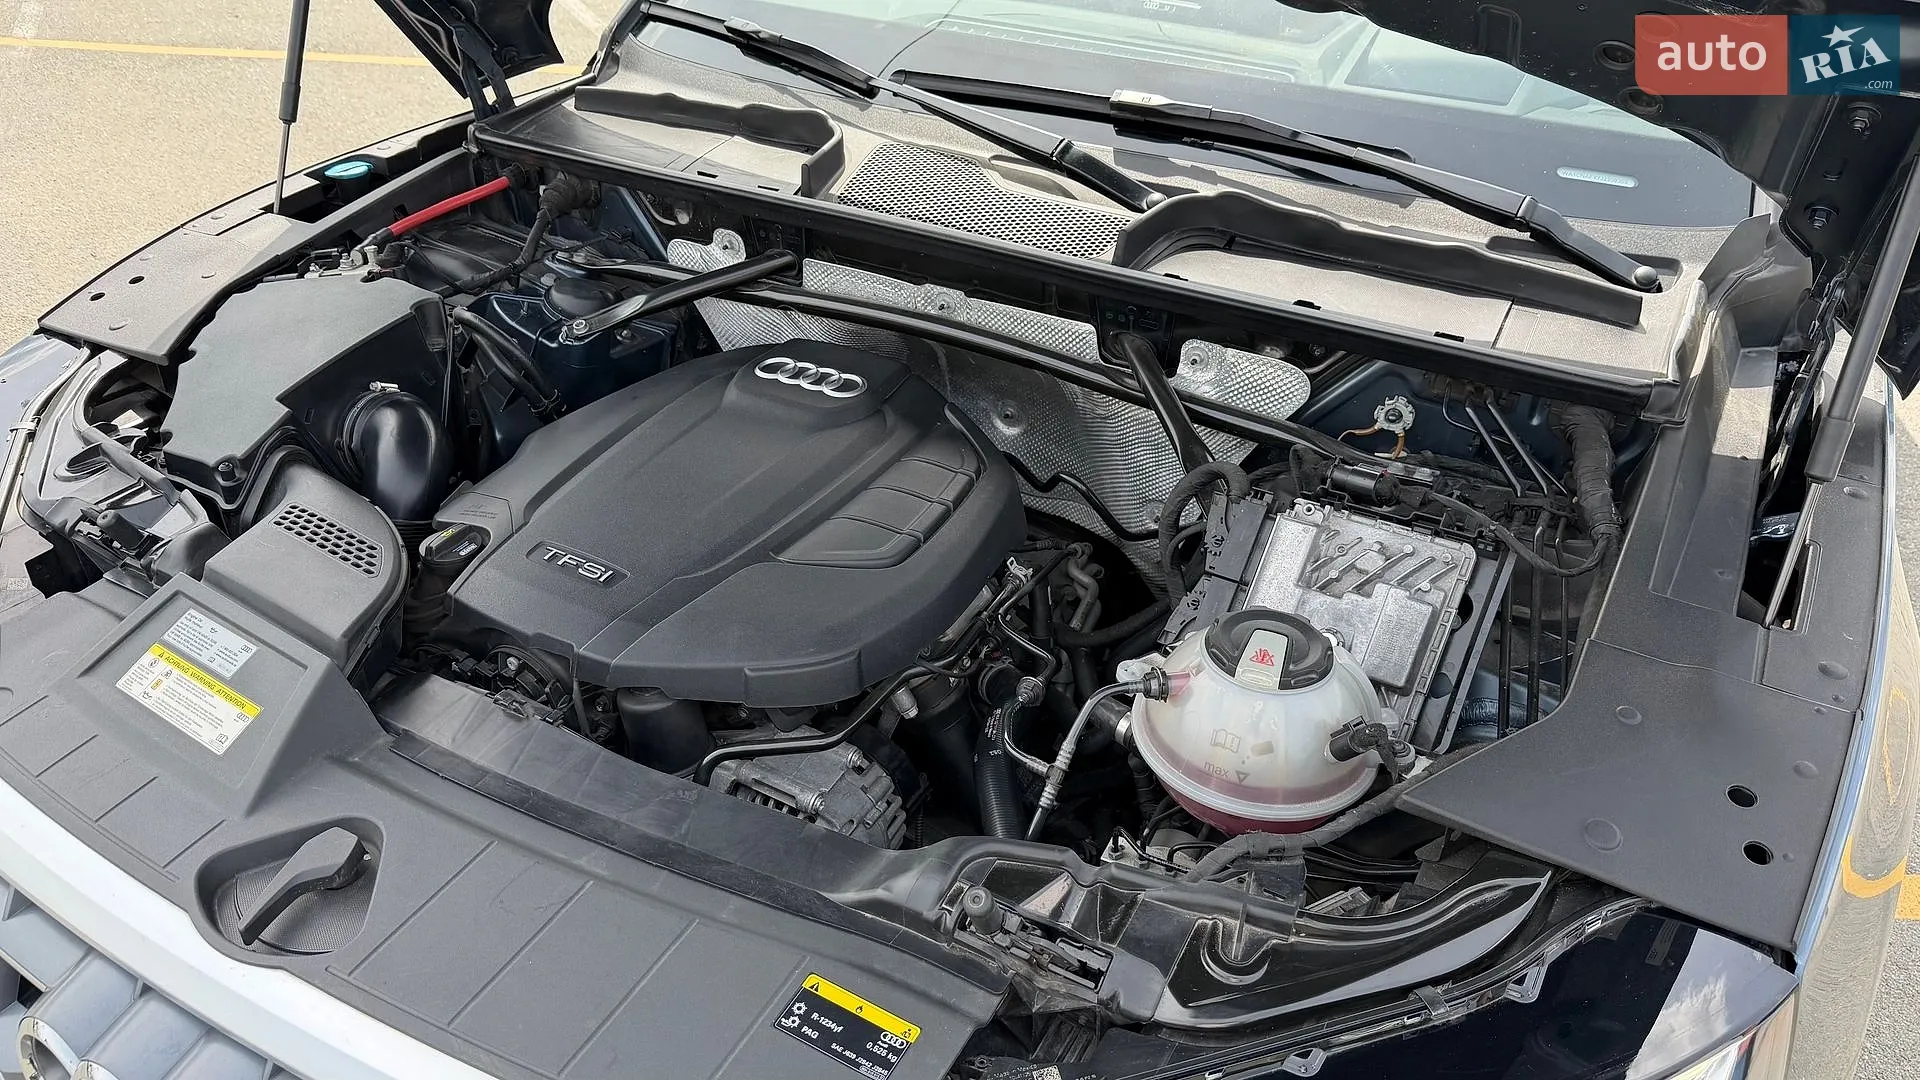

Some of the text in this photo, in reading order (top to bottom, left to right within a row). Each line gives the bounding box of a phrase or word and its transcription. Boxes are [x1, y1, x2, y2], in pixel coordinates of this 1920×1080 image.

[543, 546, 613, 582] TFSI
[165, 654, 190, 674] ACHTUNG
[190, 671, 215, 691] WARNING
[216, 688, 246, 709] ATTENTION
[1204, 761, 1230, 777] max
[801, 1026, 819, 1039] PAG
[811, 1012, 844, 1033] R-1234yf
[831, 1042, 844, 1053] SAE
[866, 1041, 898, 1063] 0,525 kg
